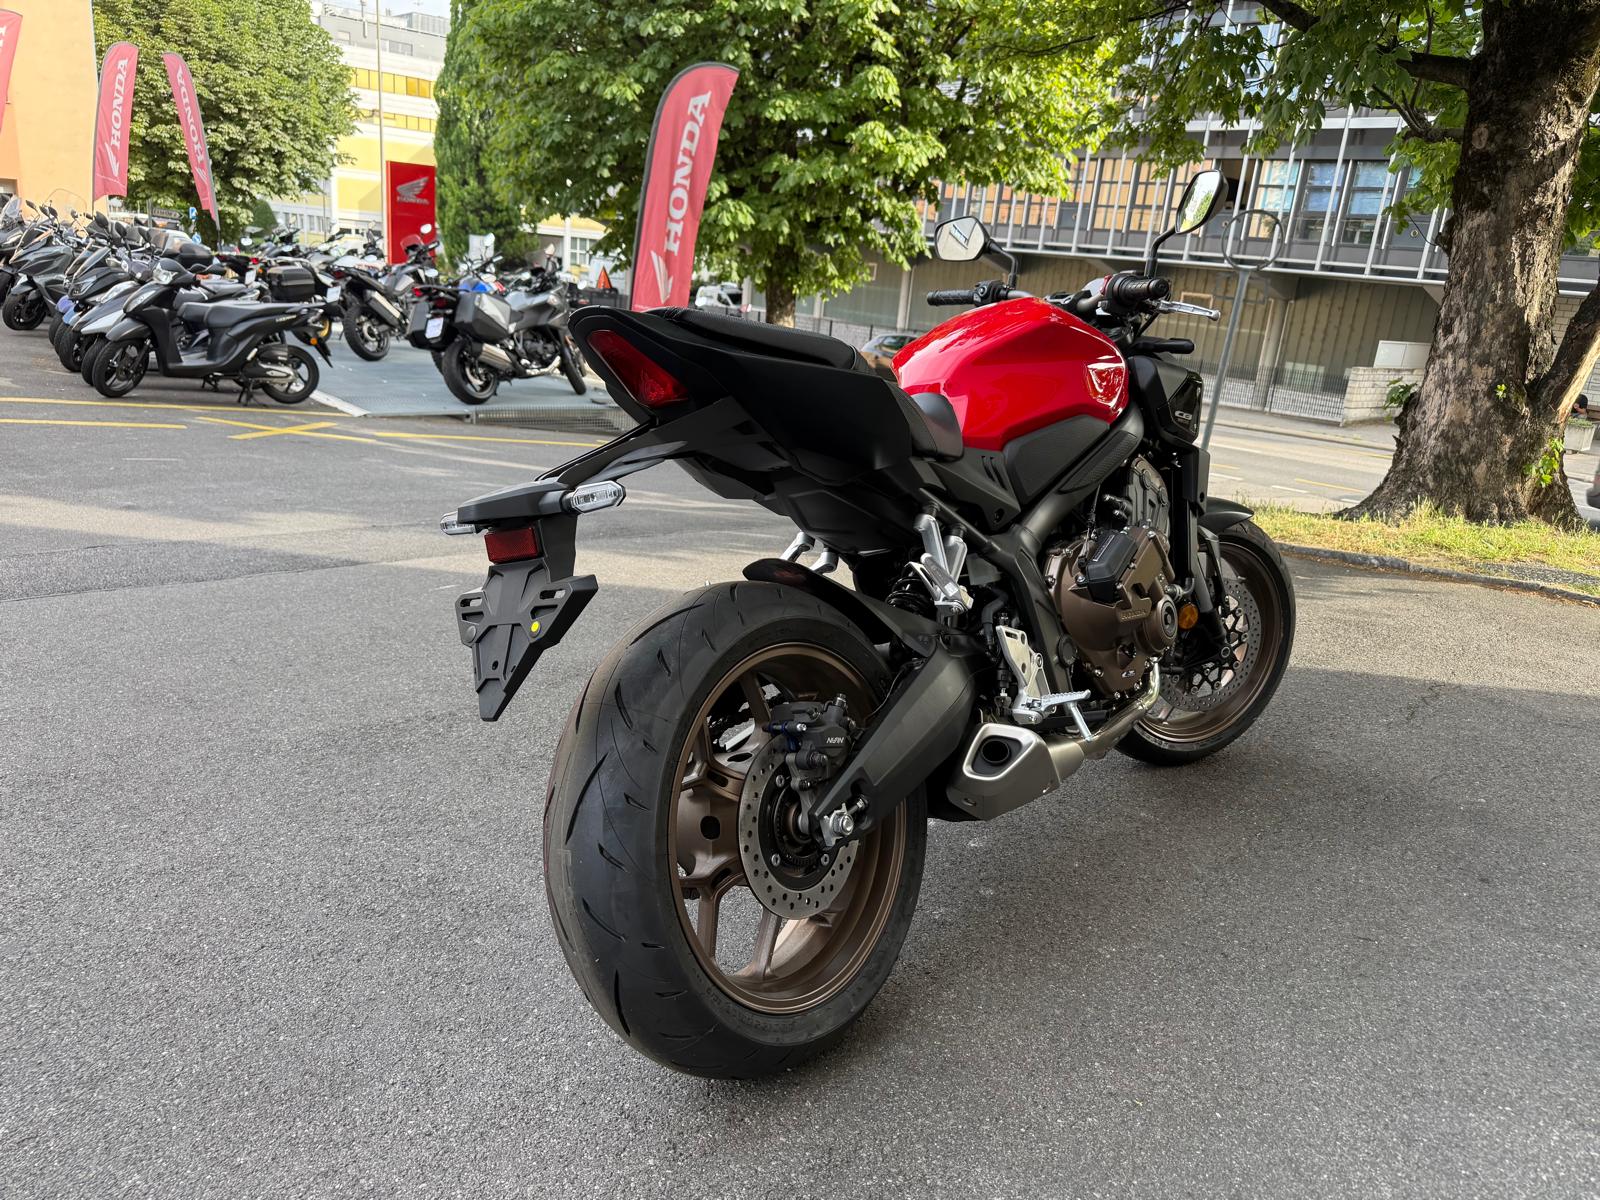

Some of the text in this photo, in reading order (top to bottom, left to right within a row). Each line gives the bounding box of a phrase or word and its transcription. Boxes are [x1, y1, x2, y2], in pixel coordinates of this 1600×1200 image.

[111, 58, 129, 148] HONDA
[176, 65, 204, 164] HONDA
[664, 90, 712, 257] HONDA
[1174, 410, 1193, 421] CB
